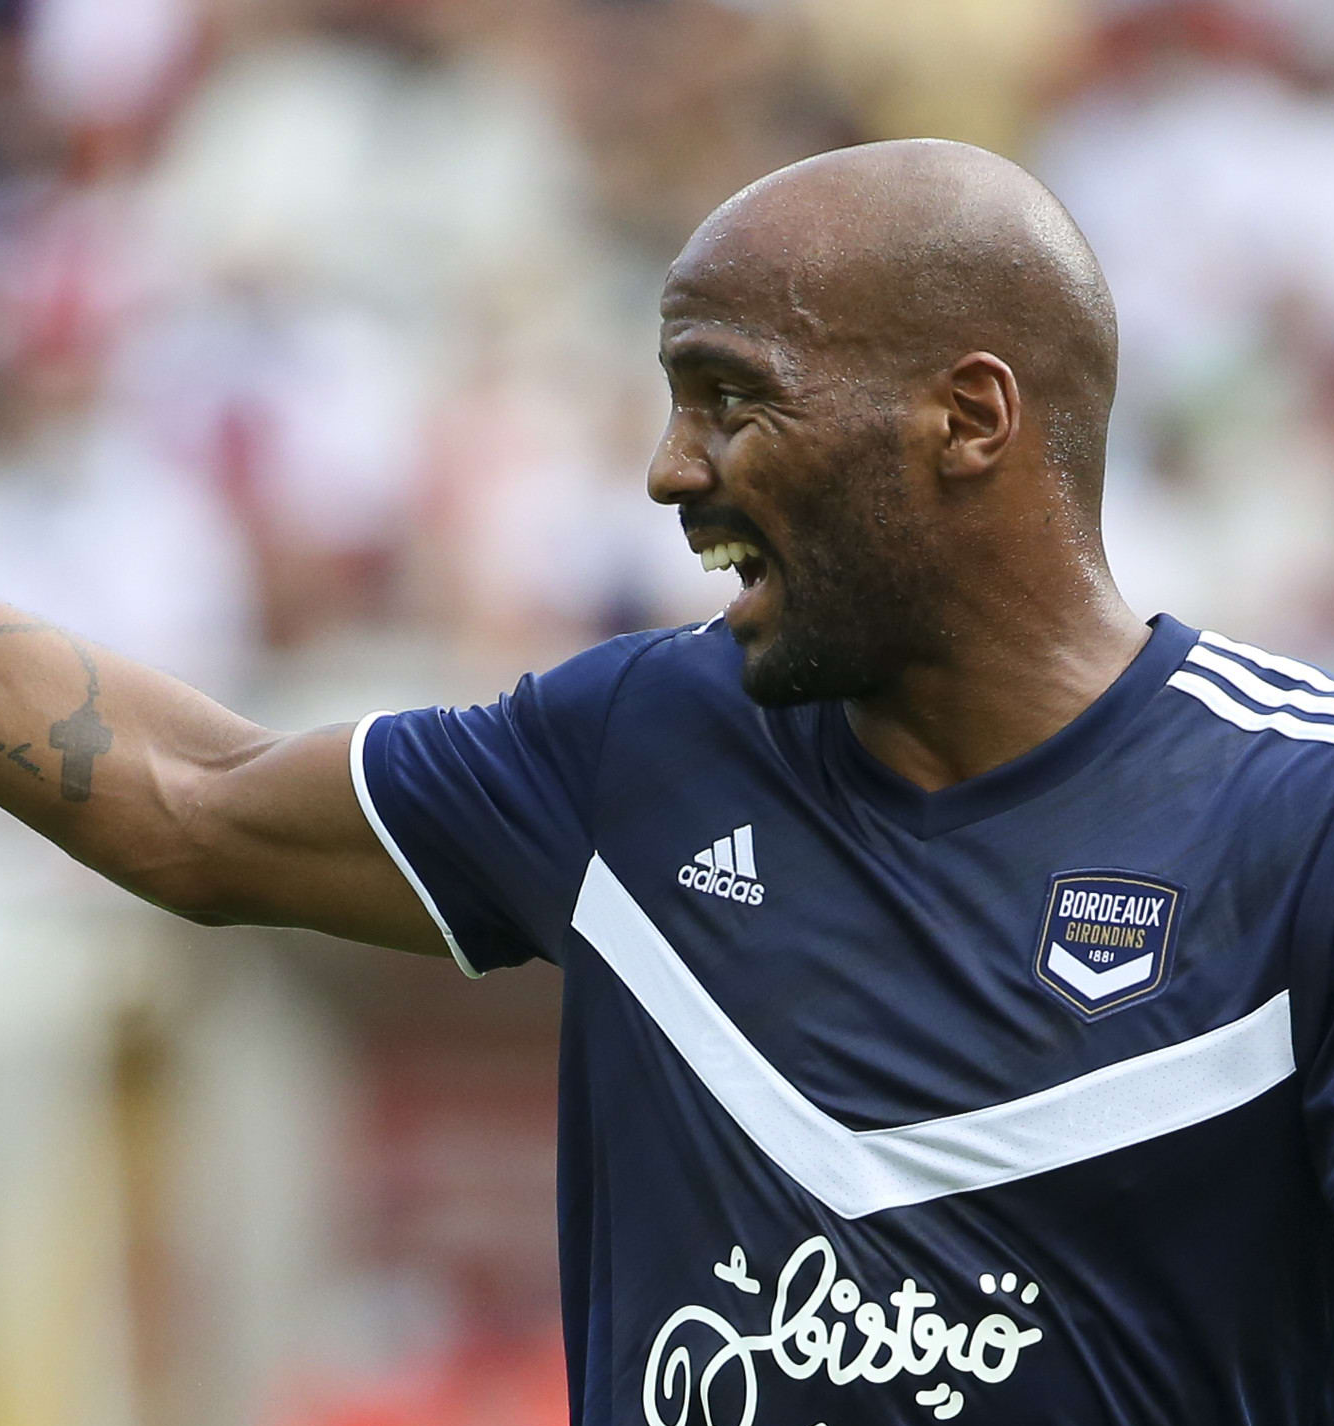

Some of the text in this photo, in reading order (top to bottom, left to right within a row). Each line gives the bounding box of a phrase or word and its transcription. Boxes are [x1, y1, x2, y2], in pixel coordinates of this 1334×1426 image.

[677, 865, 765, 906] adidas
[1058, 889, 1165, 927] BORDEAUX
[1065, 921, 1146, 949] GIRONDINS
[1088, 950, 1115, 963] 1881
[770, 1235, 1043, 1386] bistro
